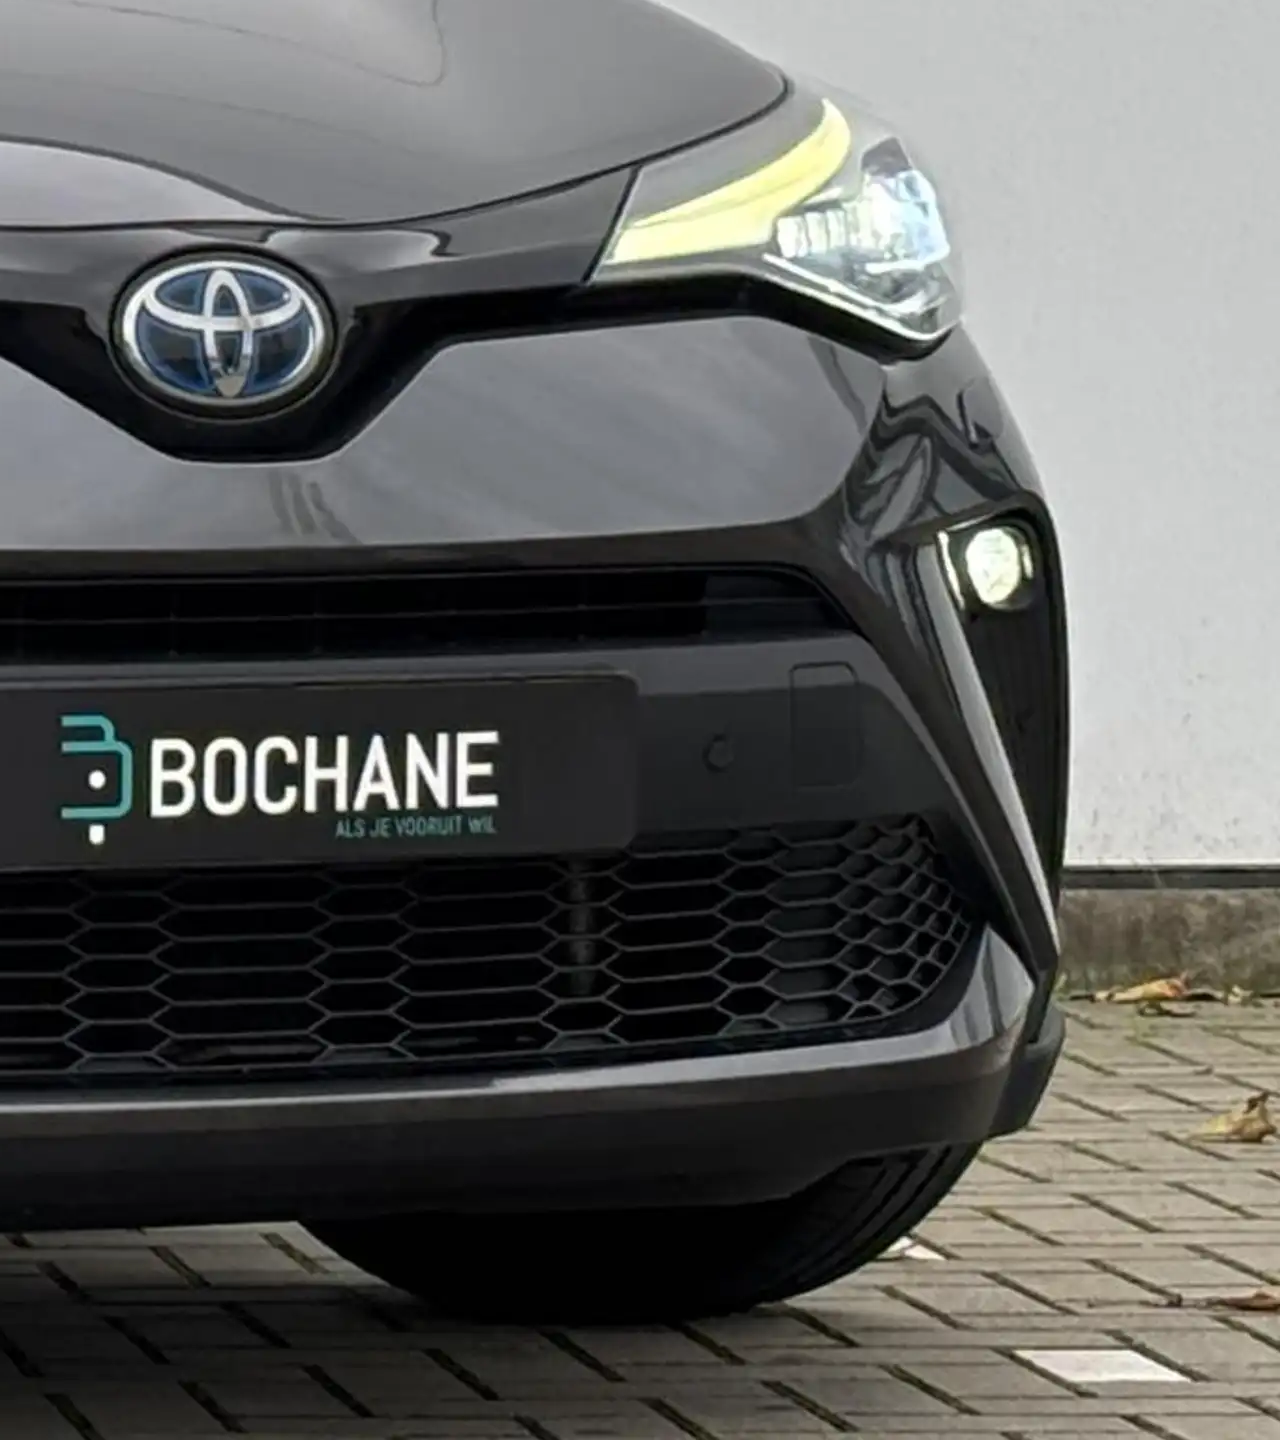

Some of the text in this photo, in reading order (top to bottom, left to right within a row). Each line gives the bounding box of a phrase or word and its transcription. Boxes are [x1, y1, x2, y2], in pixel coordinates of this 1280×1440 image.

[150, 731, 498, 818] BOCHANE
[335, 814, 497, 838] ALS JE VOORUIT WIL
